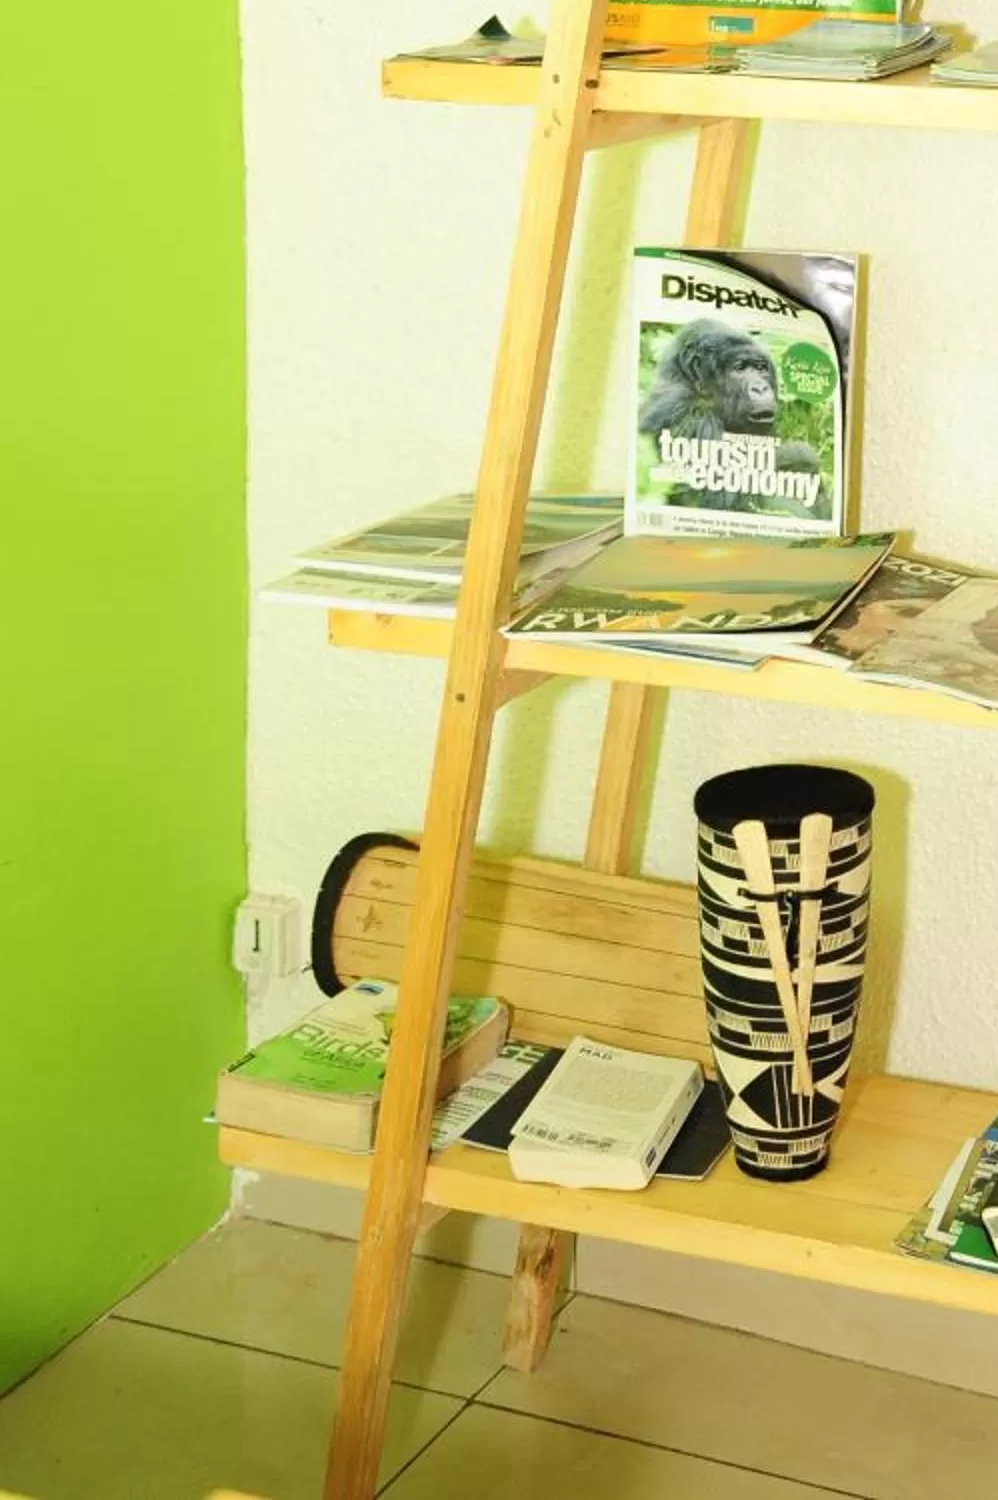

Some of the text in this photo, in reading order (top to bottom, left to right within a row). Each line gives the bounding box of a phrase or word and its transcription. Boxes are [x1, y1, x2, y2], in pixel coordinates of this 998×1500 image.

[661, 273, 799, 319] Dispatch
[659, 429, 777, 472] tourism
[690, 461, 821, 509] economy
